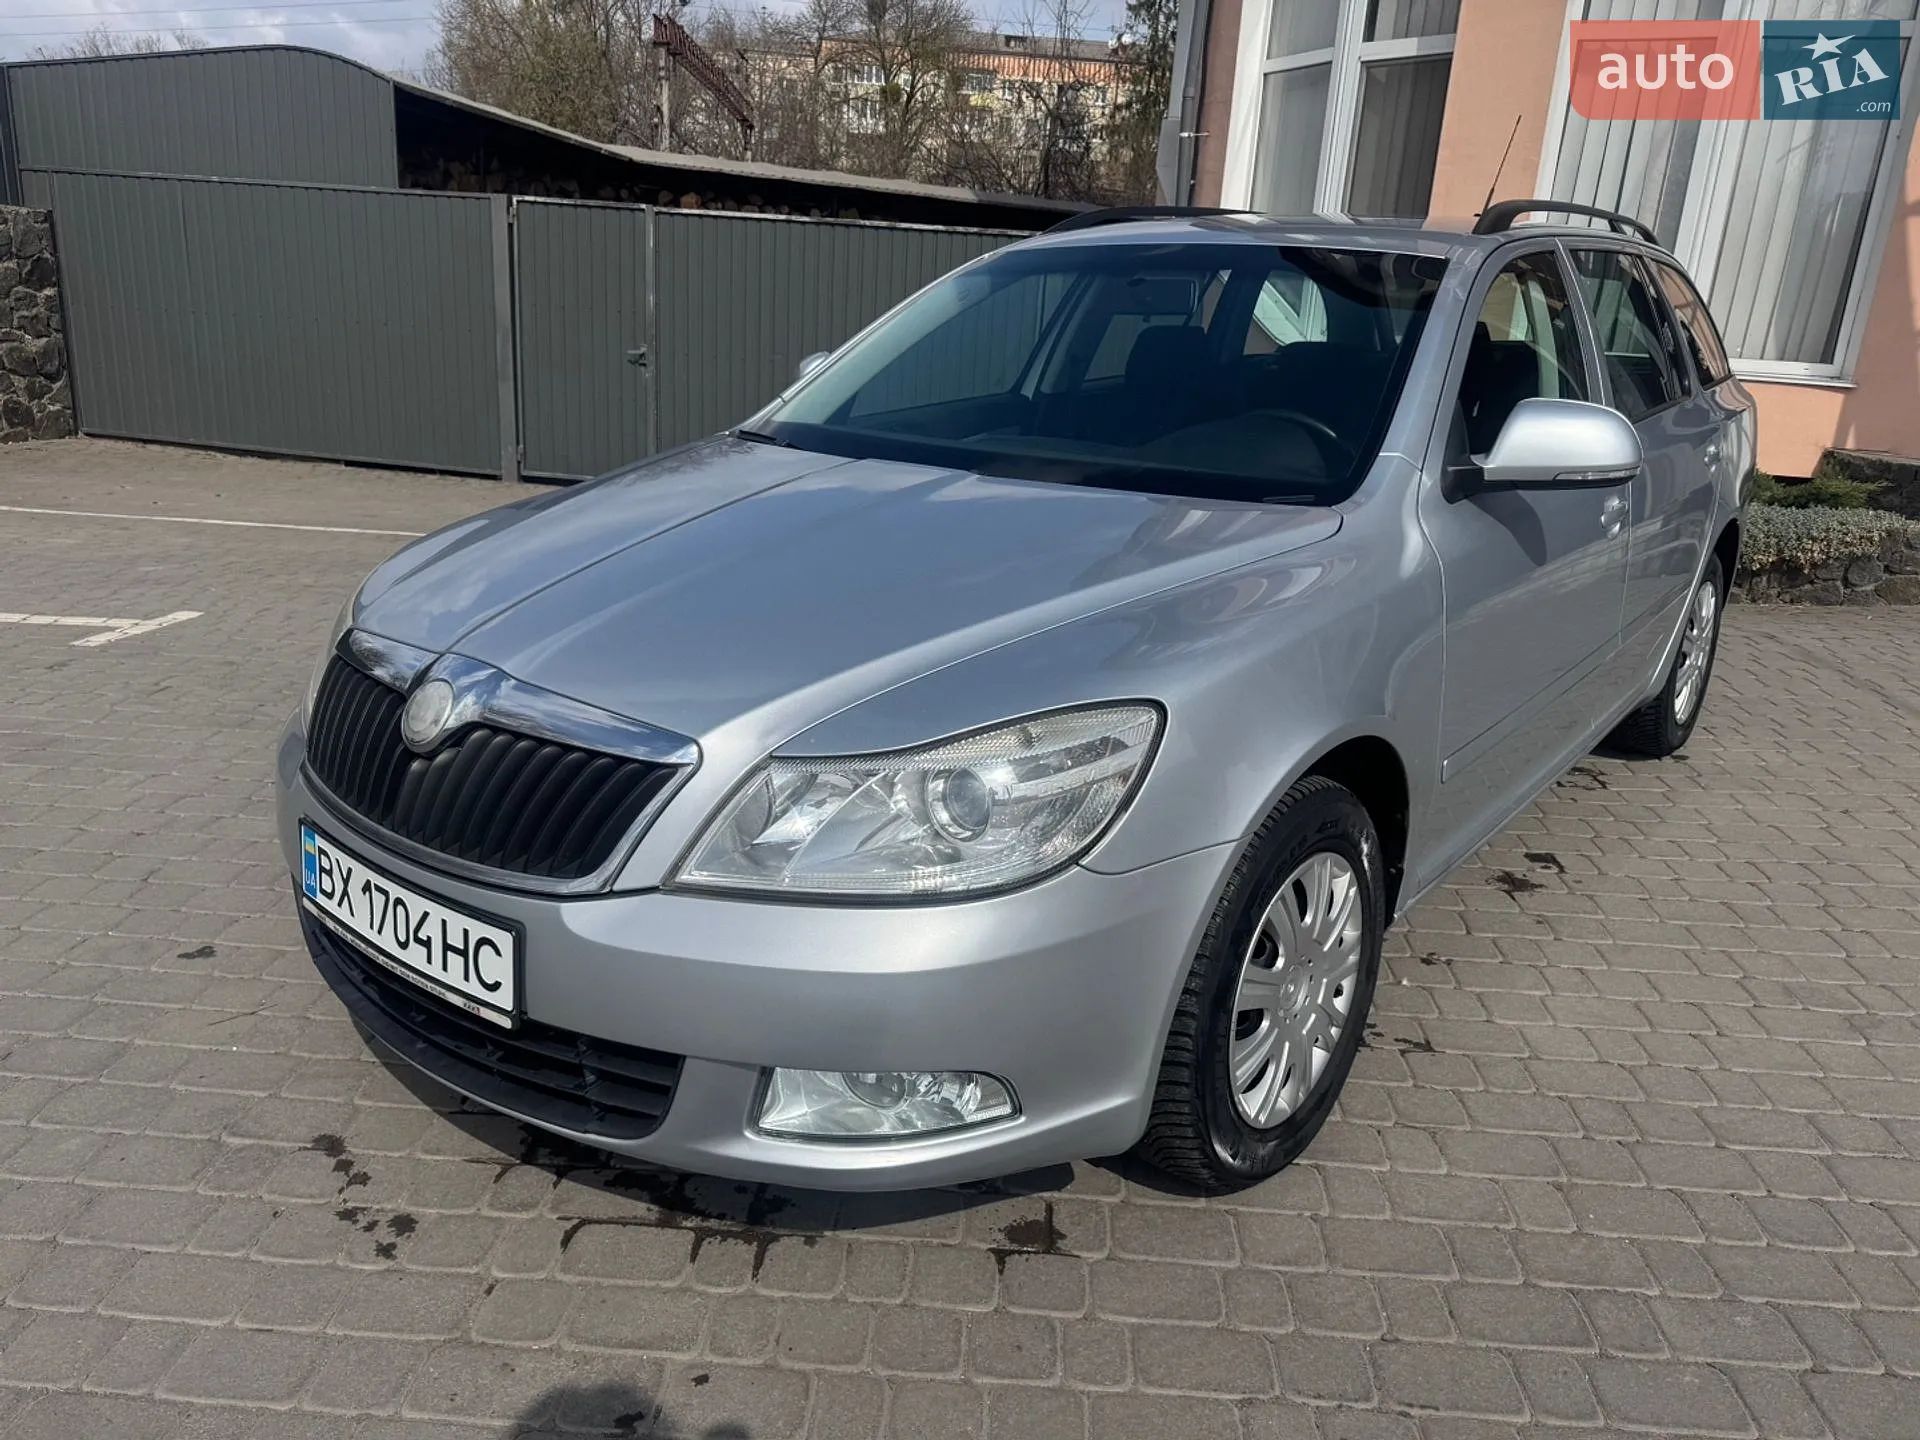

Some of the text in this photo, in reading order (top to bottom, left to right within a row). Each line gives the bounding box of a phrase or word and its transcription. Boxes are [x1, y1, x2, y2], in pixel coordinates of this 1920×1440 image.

[305, 868, 316, 889] UA
[318, 845, 355, 918] BX
[361, 878, 432, 966] 1704
[441, 918, 503, 993] HC
